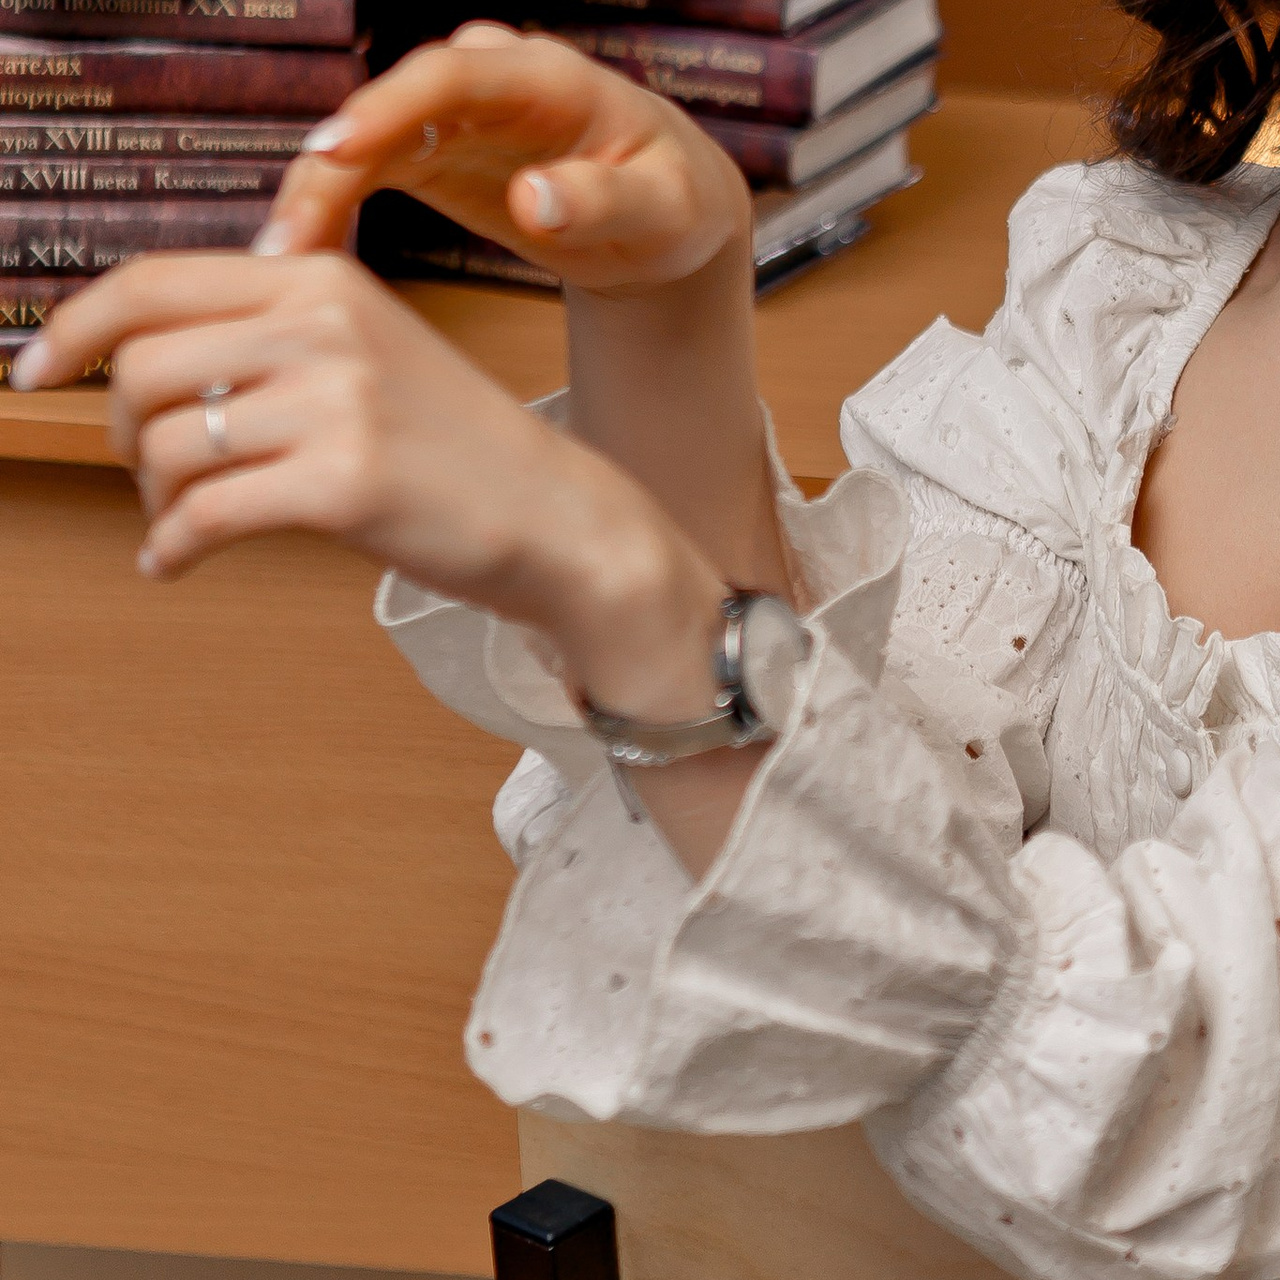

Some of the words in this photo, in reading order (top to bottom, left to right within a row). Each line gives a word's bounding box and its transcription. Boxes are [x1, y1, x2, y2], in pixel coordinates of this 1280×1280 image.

[243, 1, 297, 19] века
[0, 137, 38, 154] ура
[45, 129, 111, 151] XVIII
[117, 135, 163, 151] века
[21, 167, 87, 190] XVIII
[93, 174, 139, 191] века
[28, 241, 85, 267] XIX
